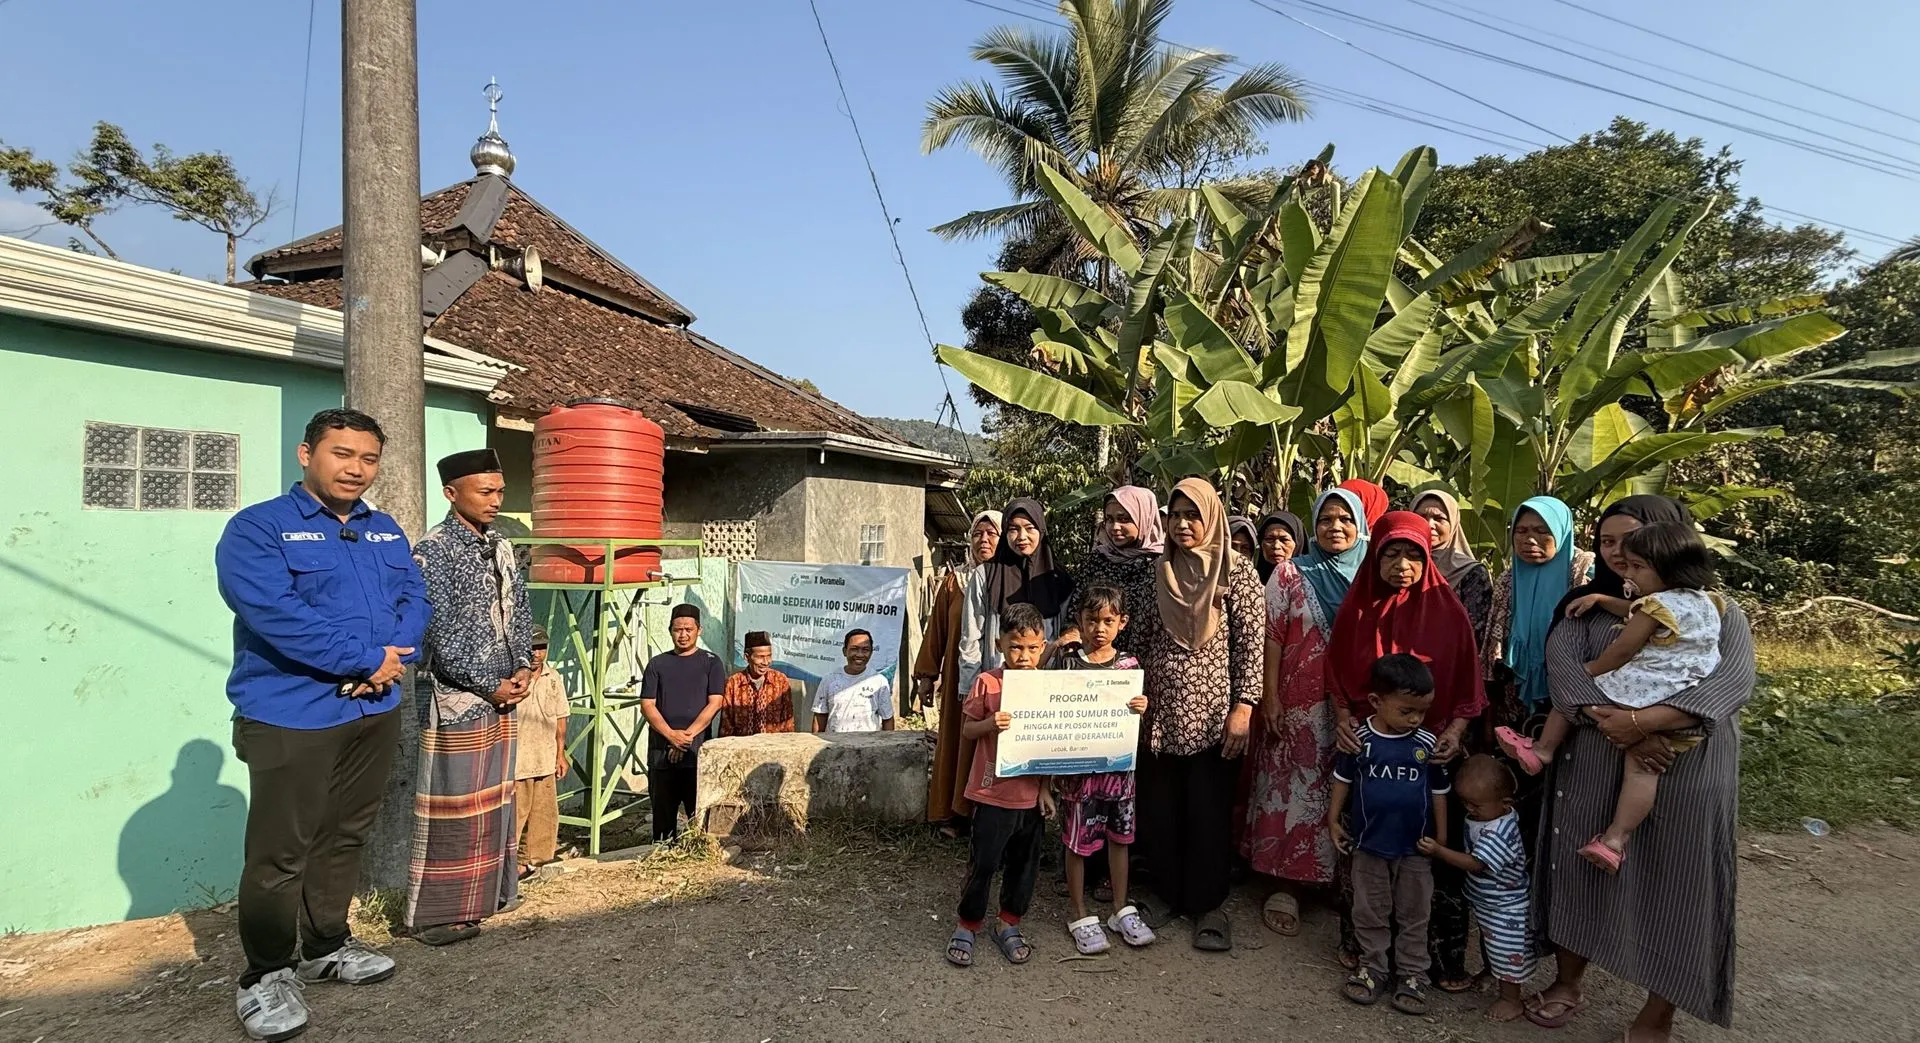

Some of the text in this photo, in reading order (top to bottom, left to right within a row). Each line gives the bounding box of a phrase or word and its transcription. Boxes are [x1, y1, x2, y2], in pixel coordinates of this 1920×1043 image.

[819, 575, 845, 586] Deramelia
[783, 596, 822, 610] SEDEKAH
[825, 600, 840, 611] 100
[843, 601, 874, 614] SUMUR
[877, 605, 898, 616] BOR
[783, 613, 845, 629] UNTUK NEGERI
[1049, 694, 1098, 703] PROGRAM
[1013, 708, 1129, 719] SEDEKAH 100 SUMUR BOR
[1023, 721, 1118, 731] HINGGA KE PLOSOK NEGERI
[1015, 731, 1124, 742] DARI SAHABAT @DERAMELIA
[1368, 764, 1419, 781] KAFD
